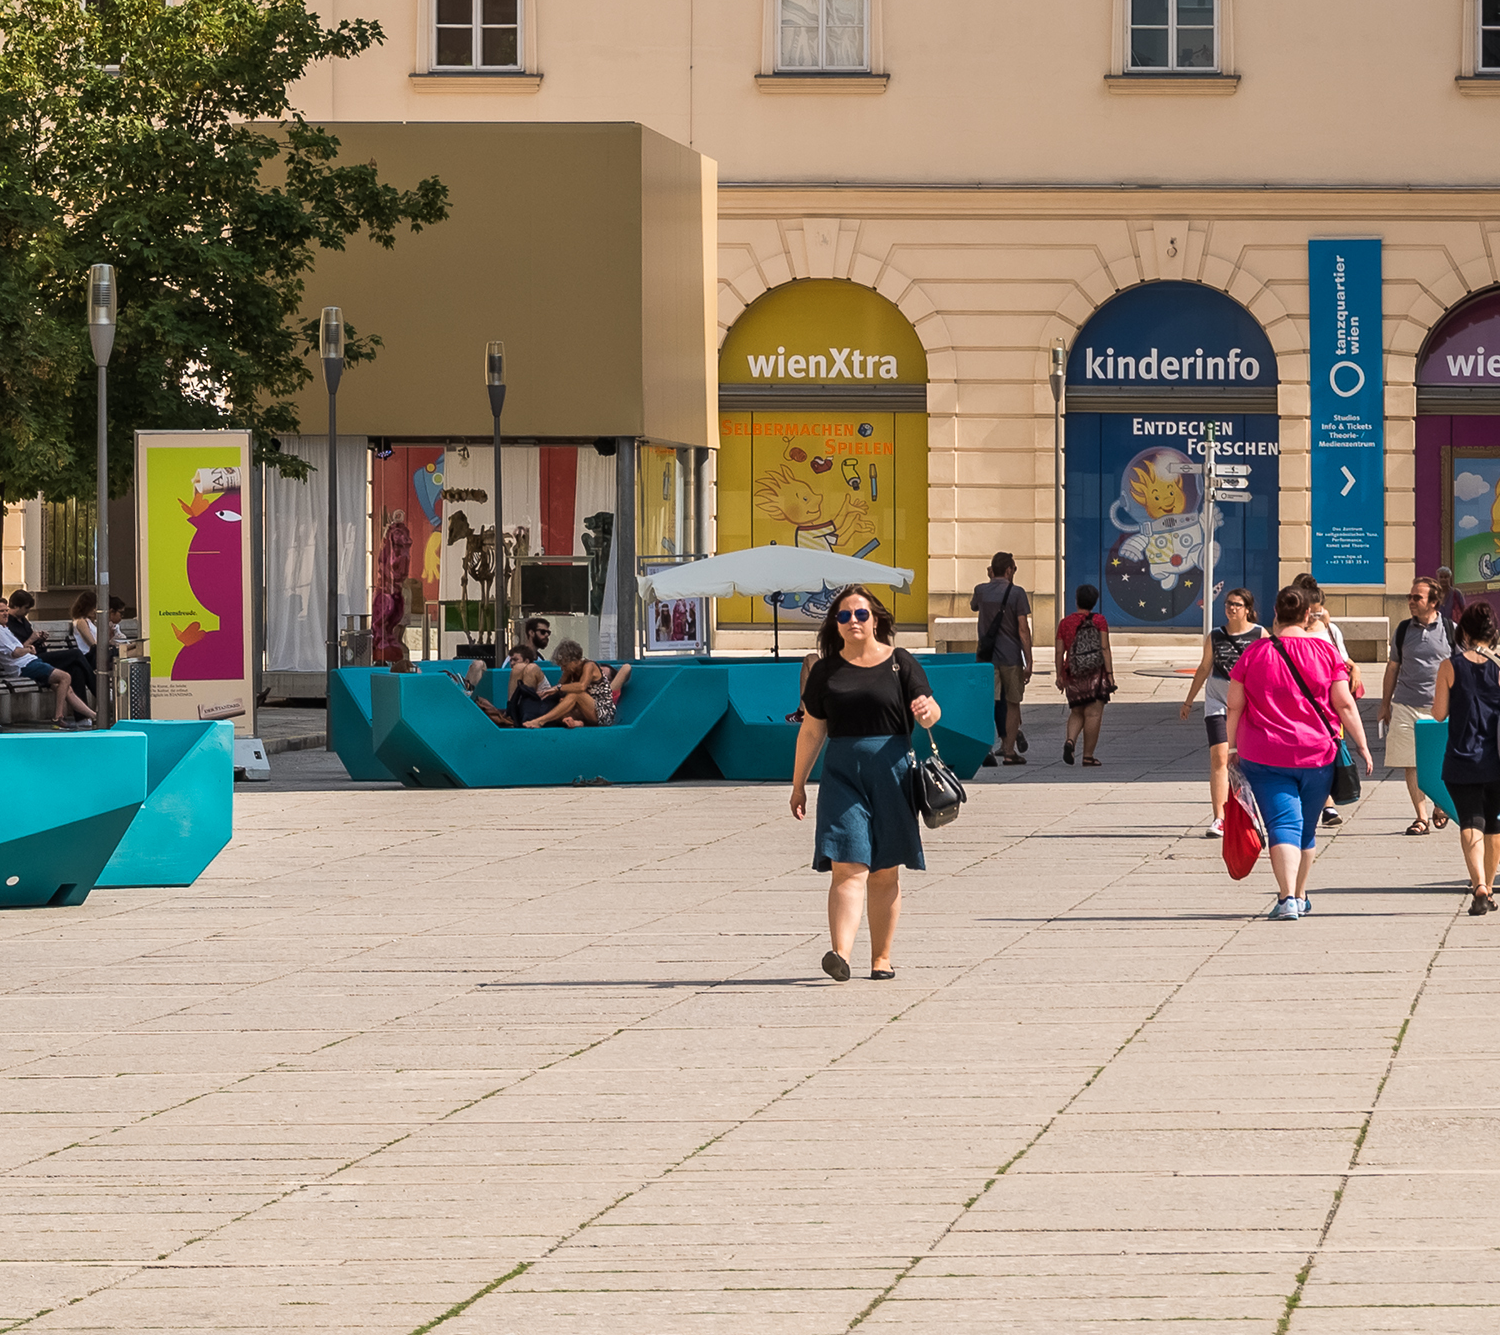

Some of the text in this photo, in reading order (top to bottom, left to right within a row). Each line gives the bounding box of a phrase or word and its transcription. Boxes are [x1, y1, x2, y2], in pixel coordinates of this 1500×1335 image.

[1333, 255, 1348, 355] tanzquartier
[1348, 316, 1359, 355] wien
[747, 346, 899, 379] wienXtra
[1085, 347, 1260, 381] kinderinfo
[721, 420, 854, 436] SELBERMACHEN
[824, 438, 893, 455] SPIELEN
[1187, 438, 1278, 455] FORSCHEN
